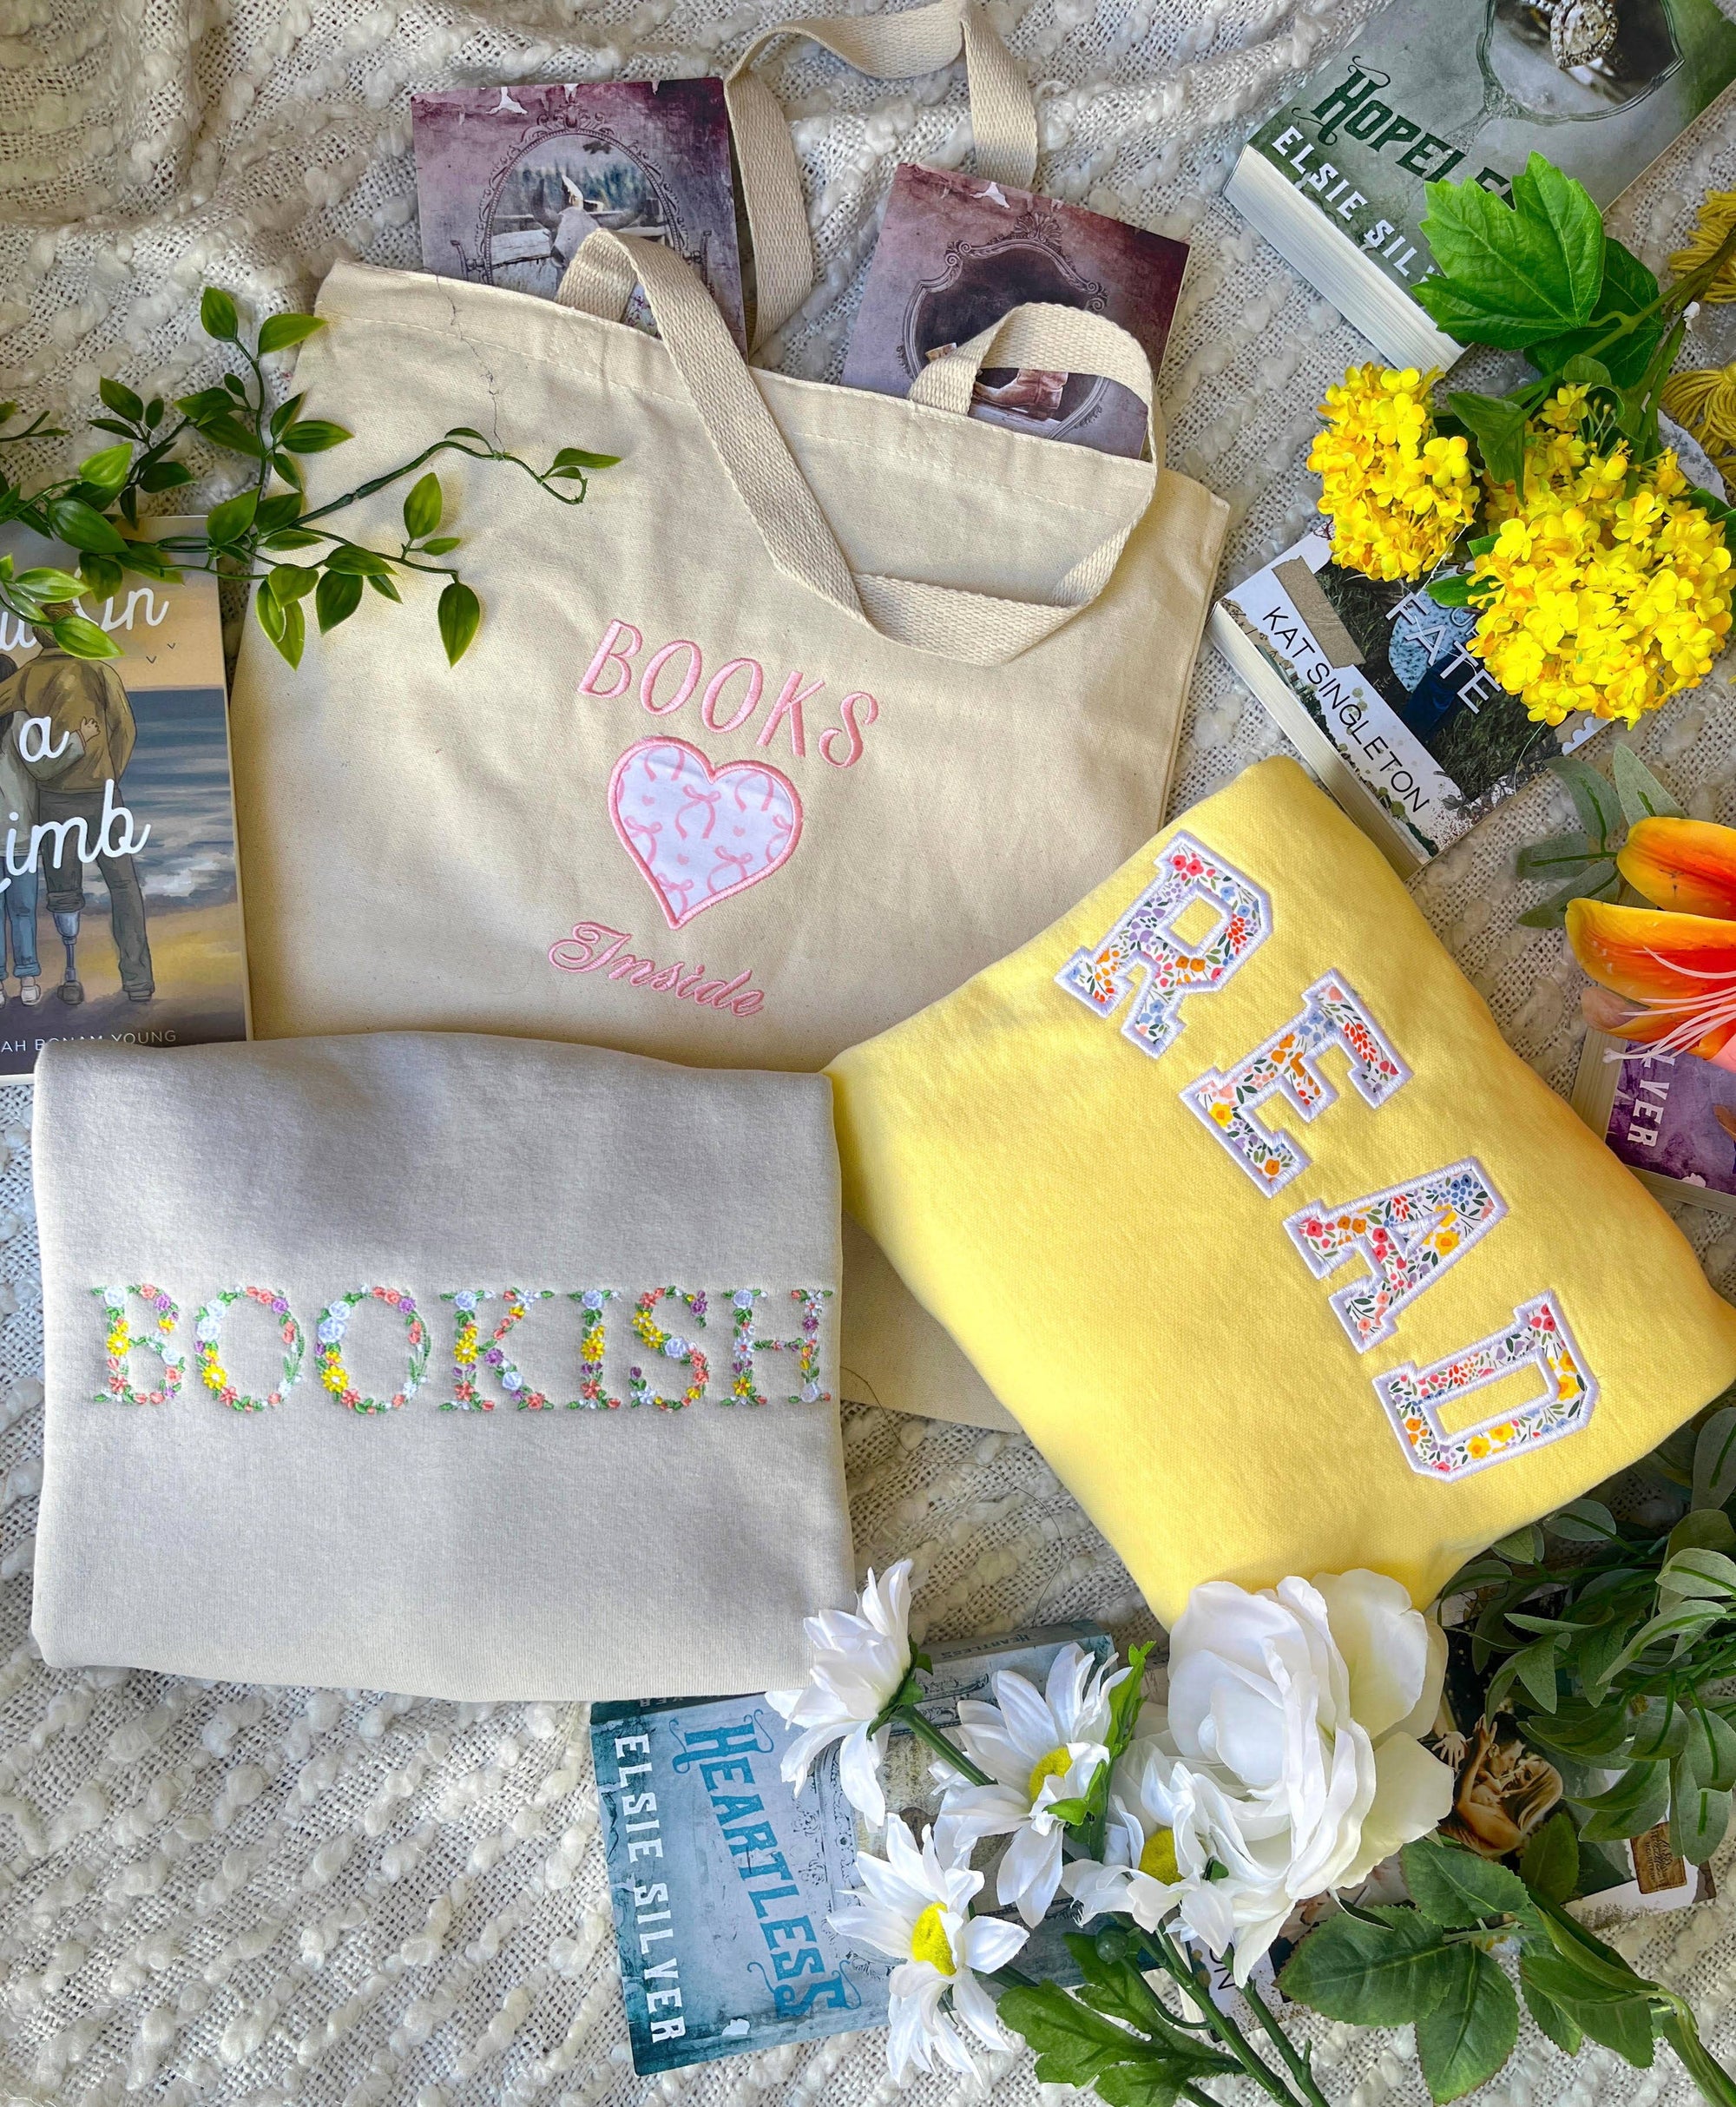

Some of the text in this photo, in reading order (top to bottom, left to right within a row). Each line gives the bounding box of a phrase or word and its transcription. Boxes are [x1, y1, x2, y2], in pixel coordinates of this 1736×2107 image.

[1272, 125, 1369, 221] ELSIE
[577, 619, 879, 768] BOOKS
[1263, 606, 1430, 813] KAT SINGLETON
[1385, 591, 1503, 714] FATE
[19, 715, 70, 763] a
[0, 778, 152, 894] imb
[548, 920, 766, 1017] Inside
[0, 1039, 26, 1053] AH
[111, 1030, 176, 1044] YOUNG
[1053, 829, 1600, 1482] READ
[89, 1282, 834, 1414] BOOKISH
[615, 1733, 664, 1864] ELSIE
[669, 1709, 862, 2019] HEARTLESS
[634, 1881, 687, 2044] SILVER
